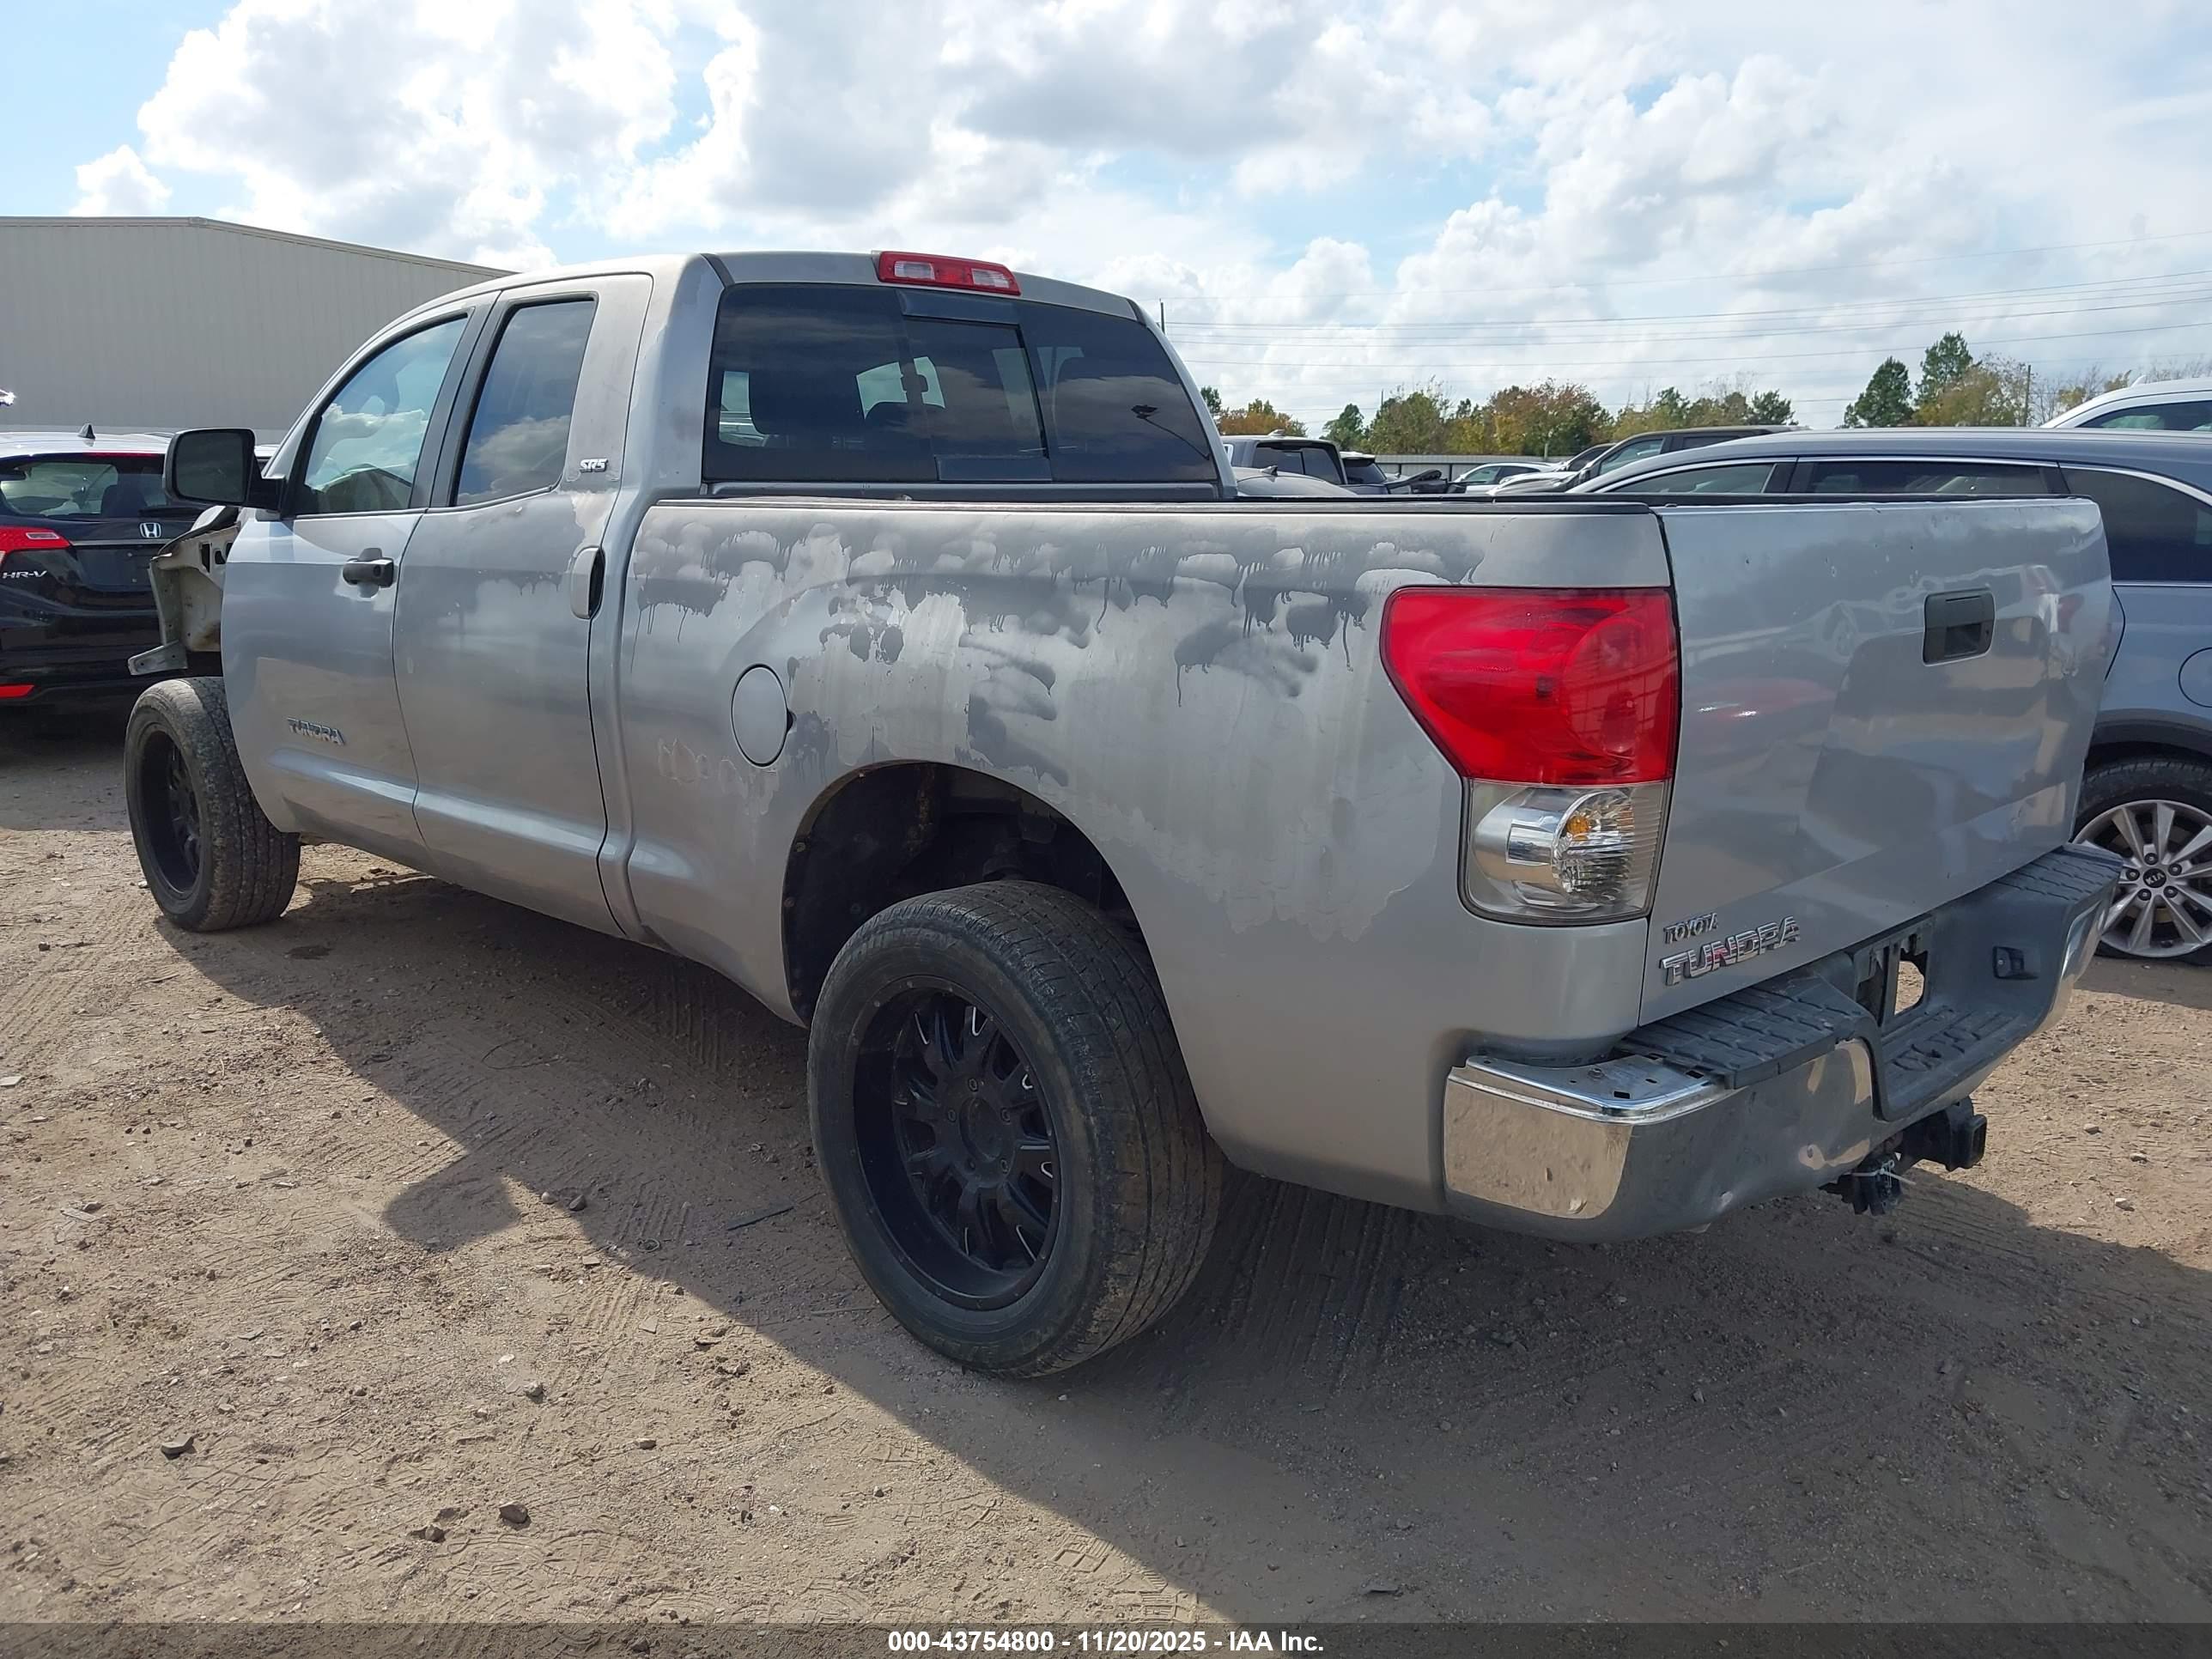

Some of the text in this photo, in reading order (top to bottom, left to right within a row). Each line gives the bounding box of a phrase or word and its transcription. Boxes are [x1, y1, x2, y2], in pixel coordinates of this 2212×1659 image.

[580, 458, 608, 472] SR5
[3, 570, 47, 579] HR-V
[2145, 872, 2165, 884] KIA
[1663, 912, 1718, 945] TOYOTA
[1659, 915, 1801, 986] TUNDRA
